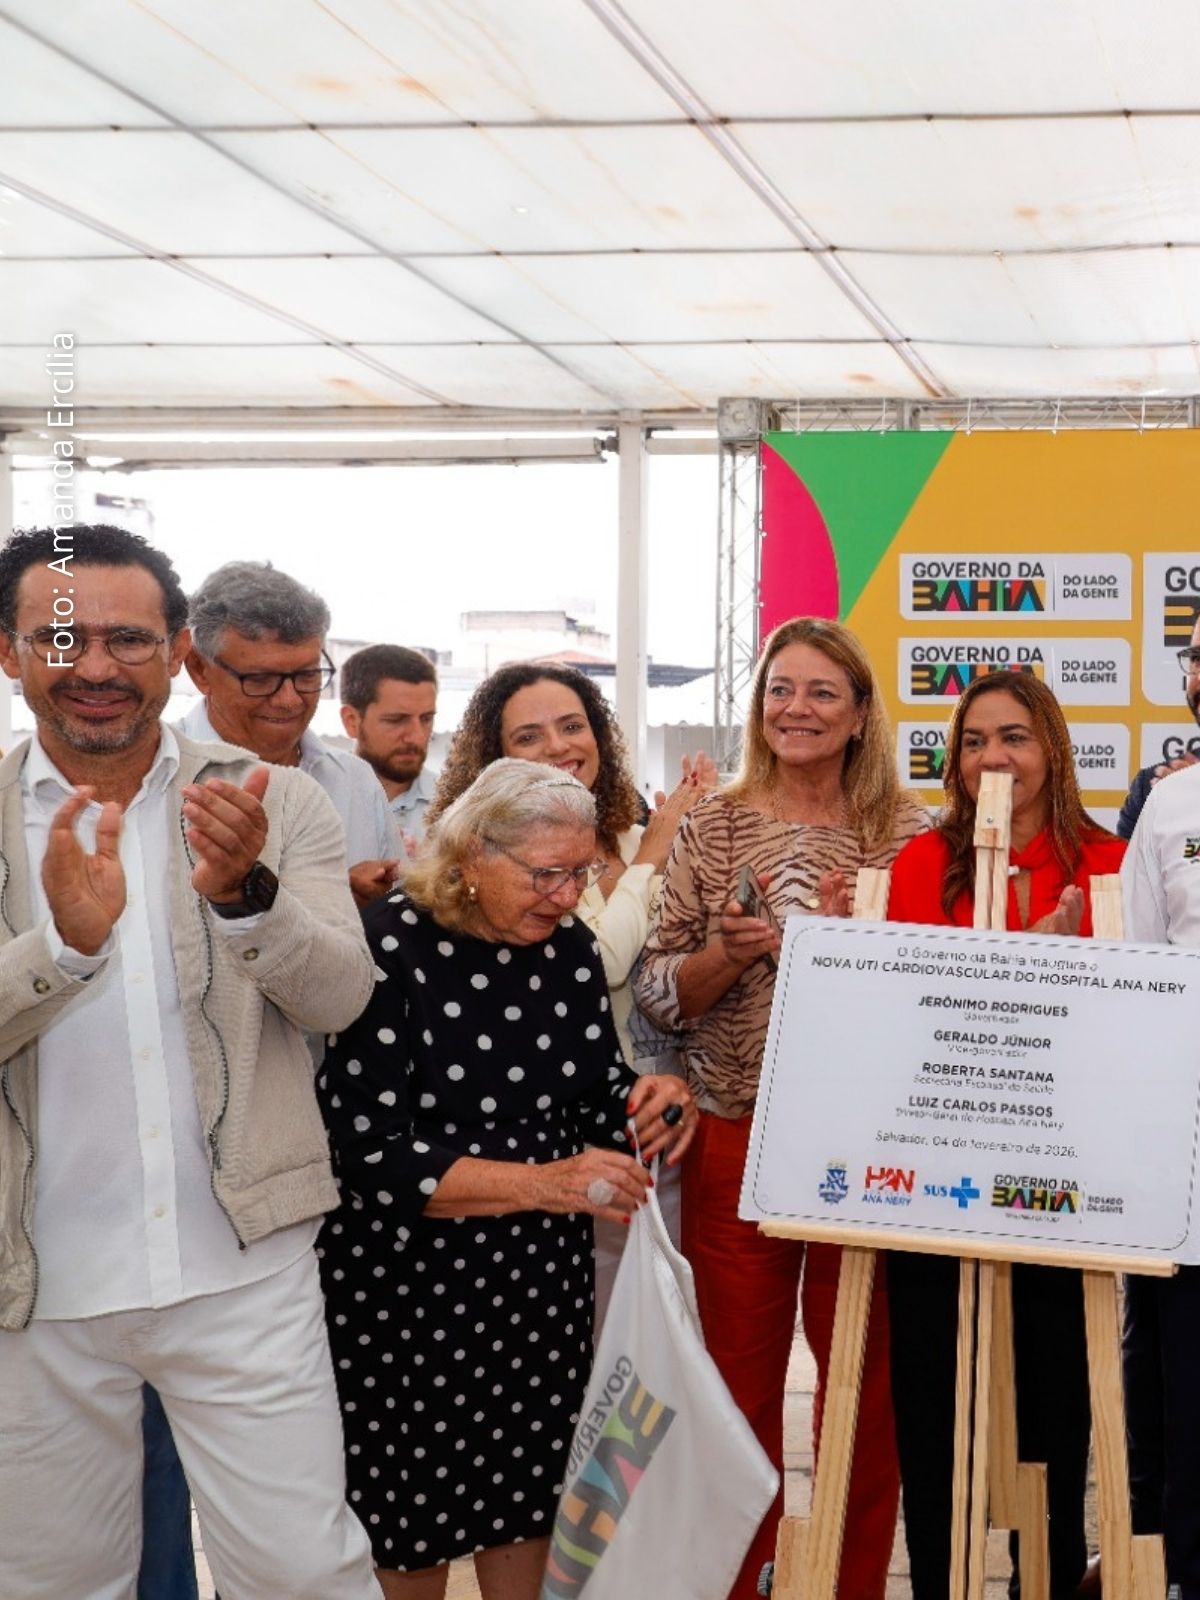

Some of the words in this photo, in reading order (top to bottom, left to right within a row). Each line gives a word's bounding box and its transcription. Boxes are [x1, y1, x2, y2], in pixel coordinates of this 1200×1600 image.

[912, 562, 1011, 578] GOVERNO
[1018, 562, 1044, 578] DA
[1063, 575, 1080, 585] DO
[1083, 575, 1117, 585] LADO
[912, 580, 1045, 611] BAHIA
[1062, 589, 1079, 598] DA
[1081, 588, 1119, 598] GENTE
[911, 647, 1010, 663] GOVERNO
[1017, 647, 1043, 662] DA
[1062, 661, 1079, 670] DO
[1083, 661, 1115, 671] LADO
[1062, 673, 1078, 683] DA
[1080, 673, 1117, 683] GENTE
[1082, 745, 1114, 755] LADO
[1079, 759, 1116, 769] GENTE
[912, 947, 967, 962] Governo
[991, 953, 1026, 966] Bahia
[1030, 955, 1087, 971] inaugura
[811, 956, 851, 969] NOVA
[856, 959, 878, 971] UTI
[882, 961, 1010, 981] CARDIOVASCULAR
[1014, 971, 1035, 983] DO
[1039, 973, 1108, 989] HOSPITAL
[1112, 979, 1143, 991] ANA
[1148, 982, 1187, 994] NERY
[918, 995, 988, 1011] JERÔNIMO
[991, 1002, 1069, 1017] RODRIGUES
[934, 1030, 998, 1045] GERALDO
[1002, 1034, 1051, 1049] JÚNIOR
[922, 1062, 985, 1078] ROBERTA
[989, 1068, 1054, 1083] SANTANA
[909, 1096, 939, 1109] LUIZ
[943, 1099, 997, 1113] CARLOS
[1000, 1103, 1053, 1118] PASSOS
[932, 1135, 948, 1146] 04
[923, 1184, 948, 1197] SUS
[994, 1174, 1057, 1190] GOVERNO
[1061, 1180, 1079, 1191] DA
[861, 1193, 882, 1205] ANA
[885, 1196, 912, 1206] NERY
[991, 1185, 1077, 1213] BAHIA
